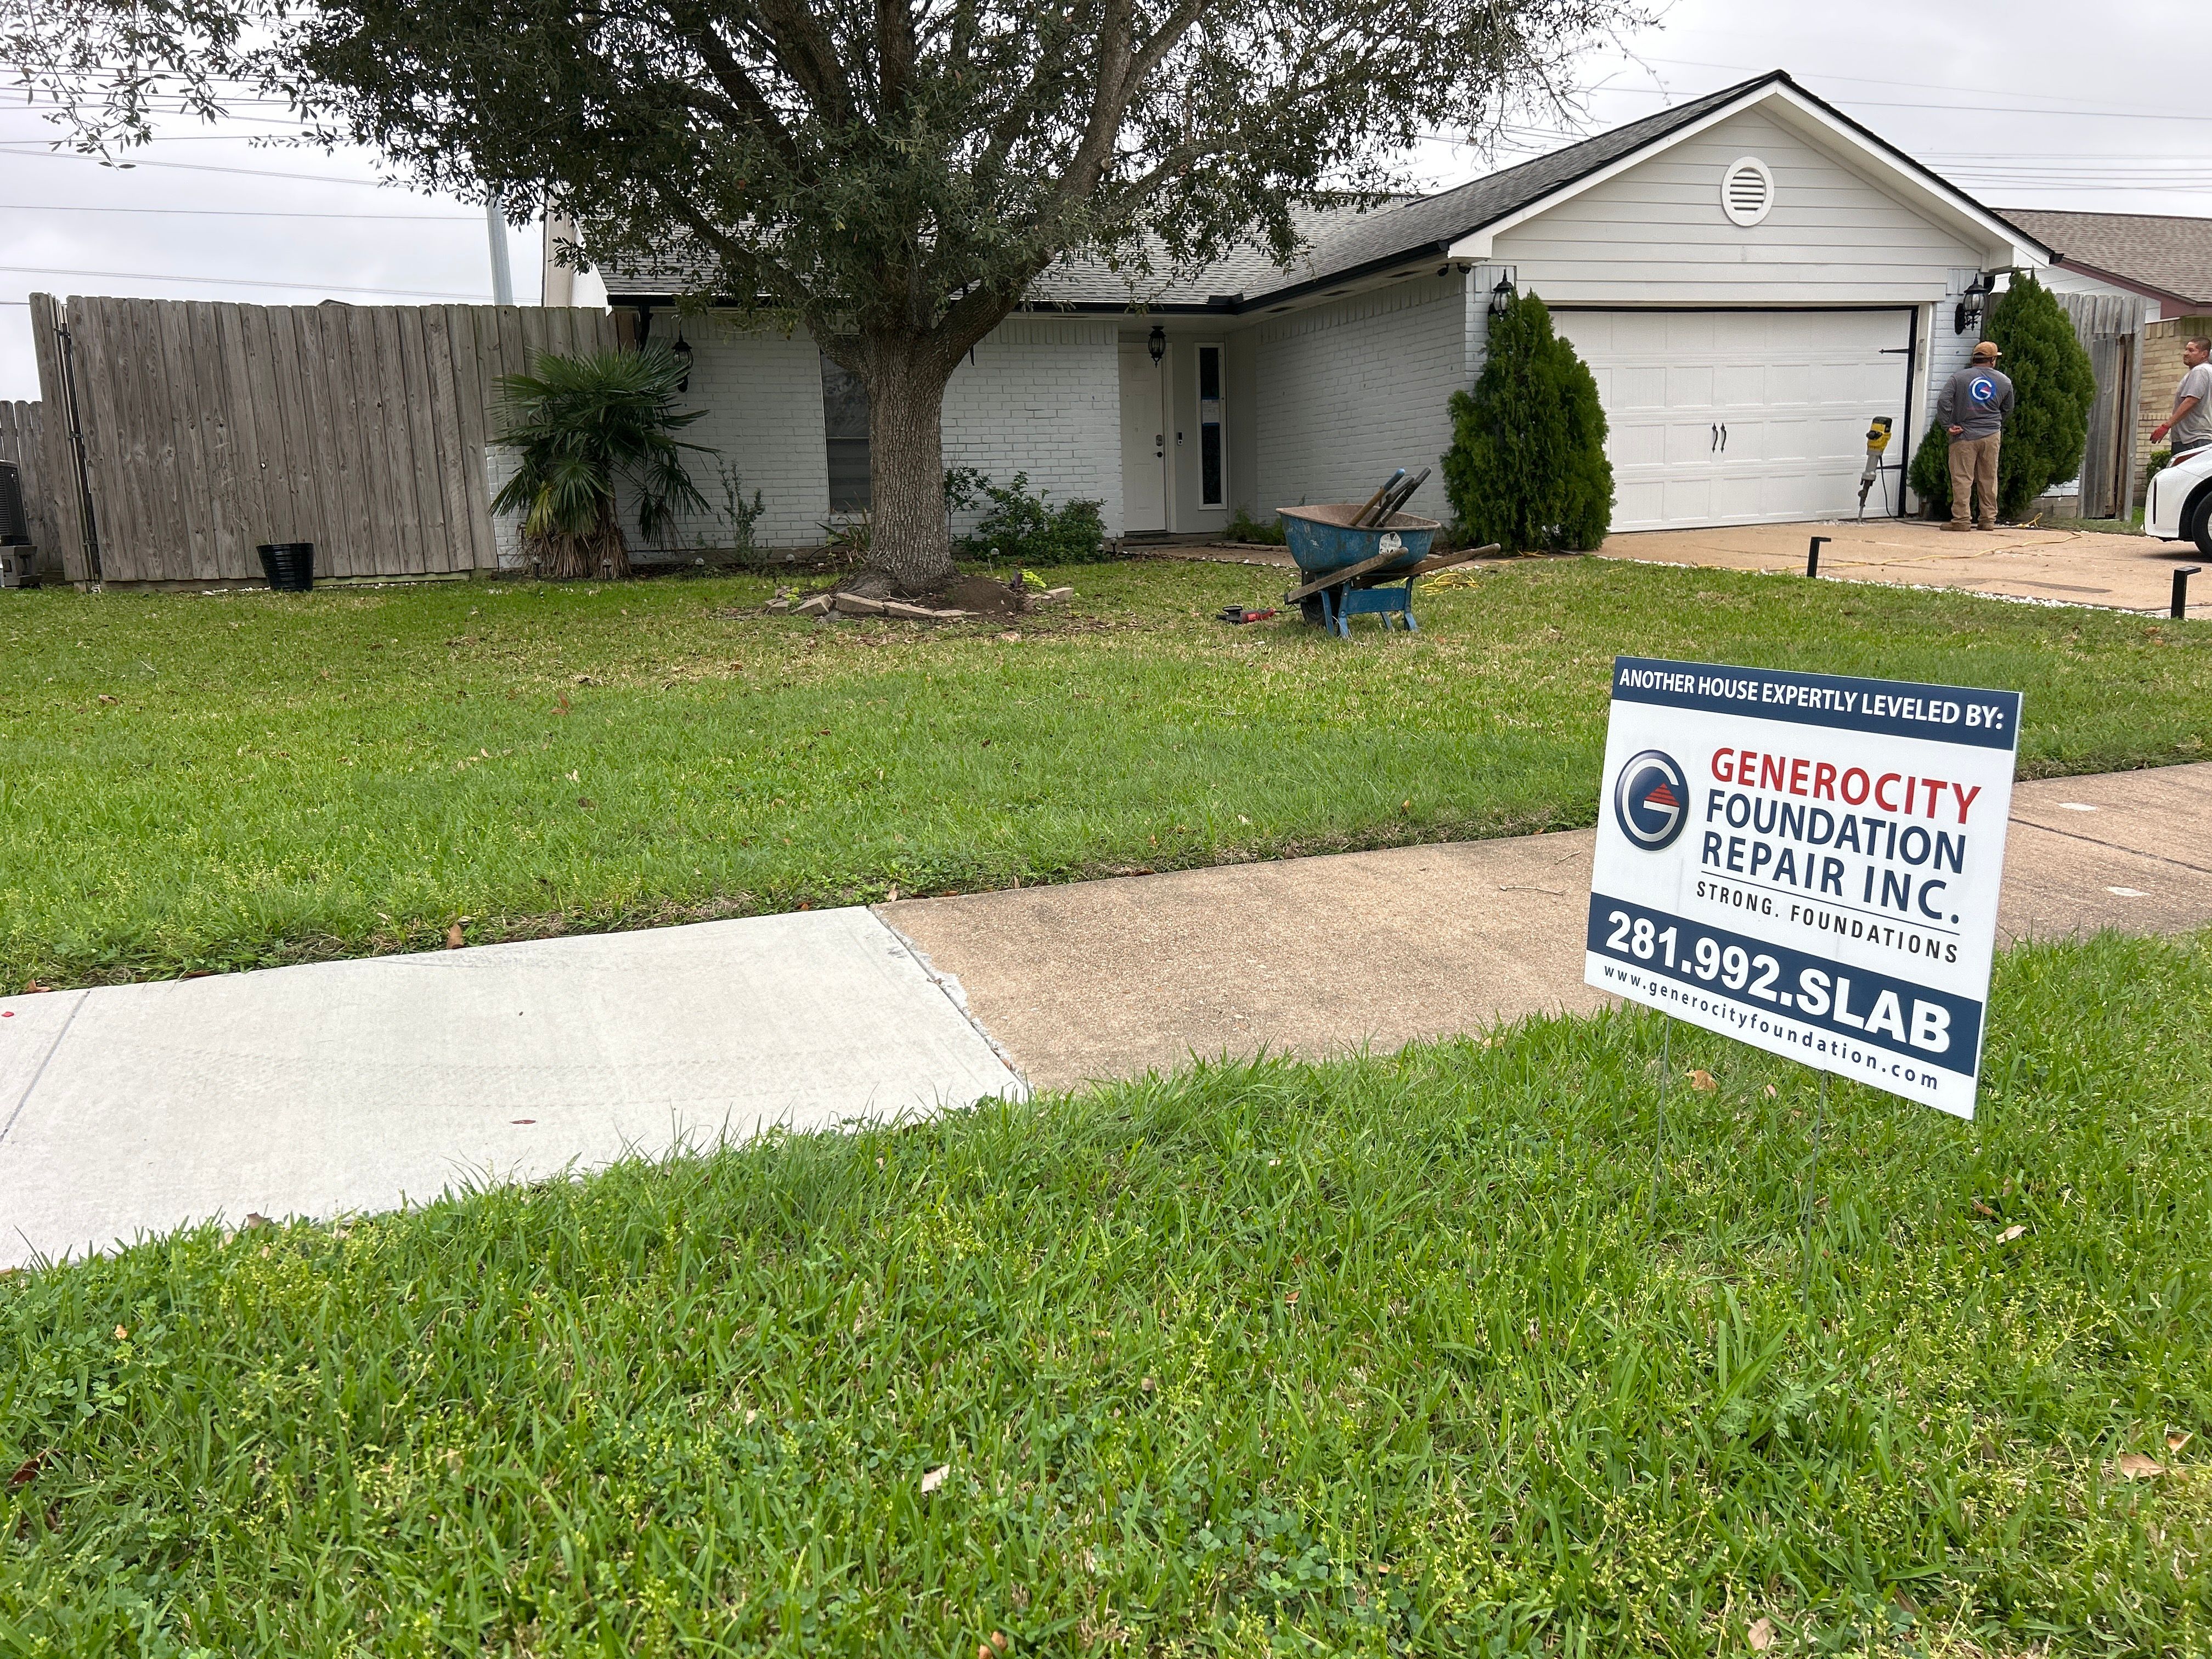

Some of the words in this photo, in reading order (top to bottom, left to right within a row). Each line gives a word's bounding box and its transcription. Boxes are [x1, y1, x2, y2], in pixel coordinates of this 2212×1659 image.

[1619, 668, 1695, 694] ANOTHER
[1698, 676, 1758, 701] HOUSE
[1762, 682, 1858, 712] EXPERTLY
[1861, 693, 1960, 724] LEVELED
[1965, 704, 2005, 730] BY:
[1711, 747, 1982, 825] GENEROCITY
[1706, 788, 1966, 874] FOUNDATION
[1701, 831, 1844, 896] REPAIR
[1863, 865, 1960, 924] INC.
[1696, 881, 1779, 917] STRONG.
[1790, 904, 1957, 963] FOUNDATIONS
[1605, 910, 1951, 1053] 281.992.SLAB
[1604, 966, 1938, 1090] www.generocityfoundation.com
